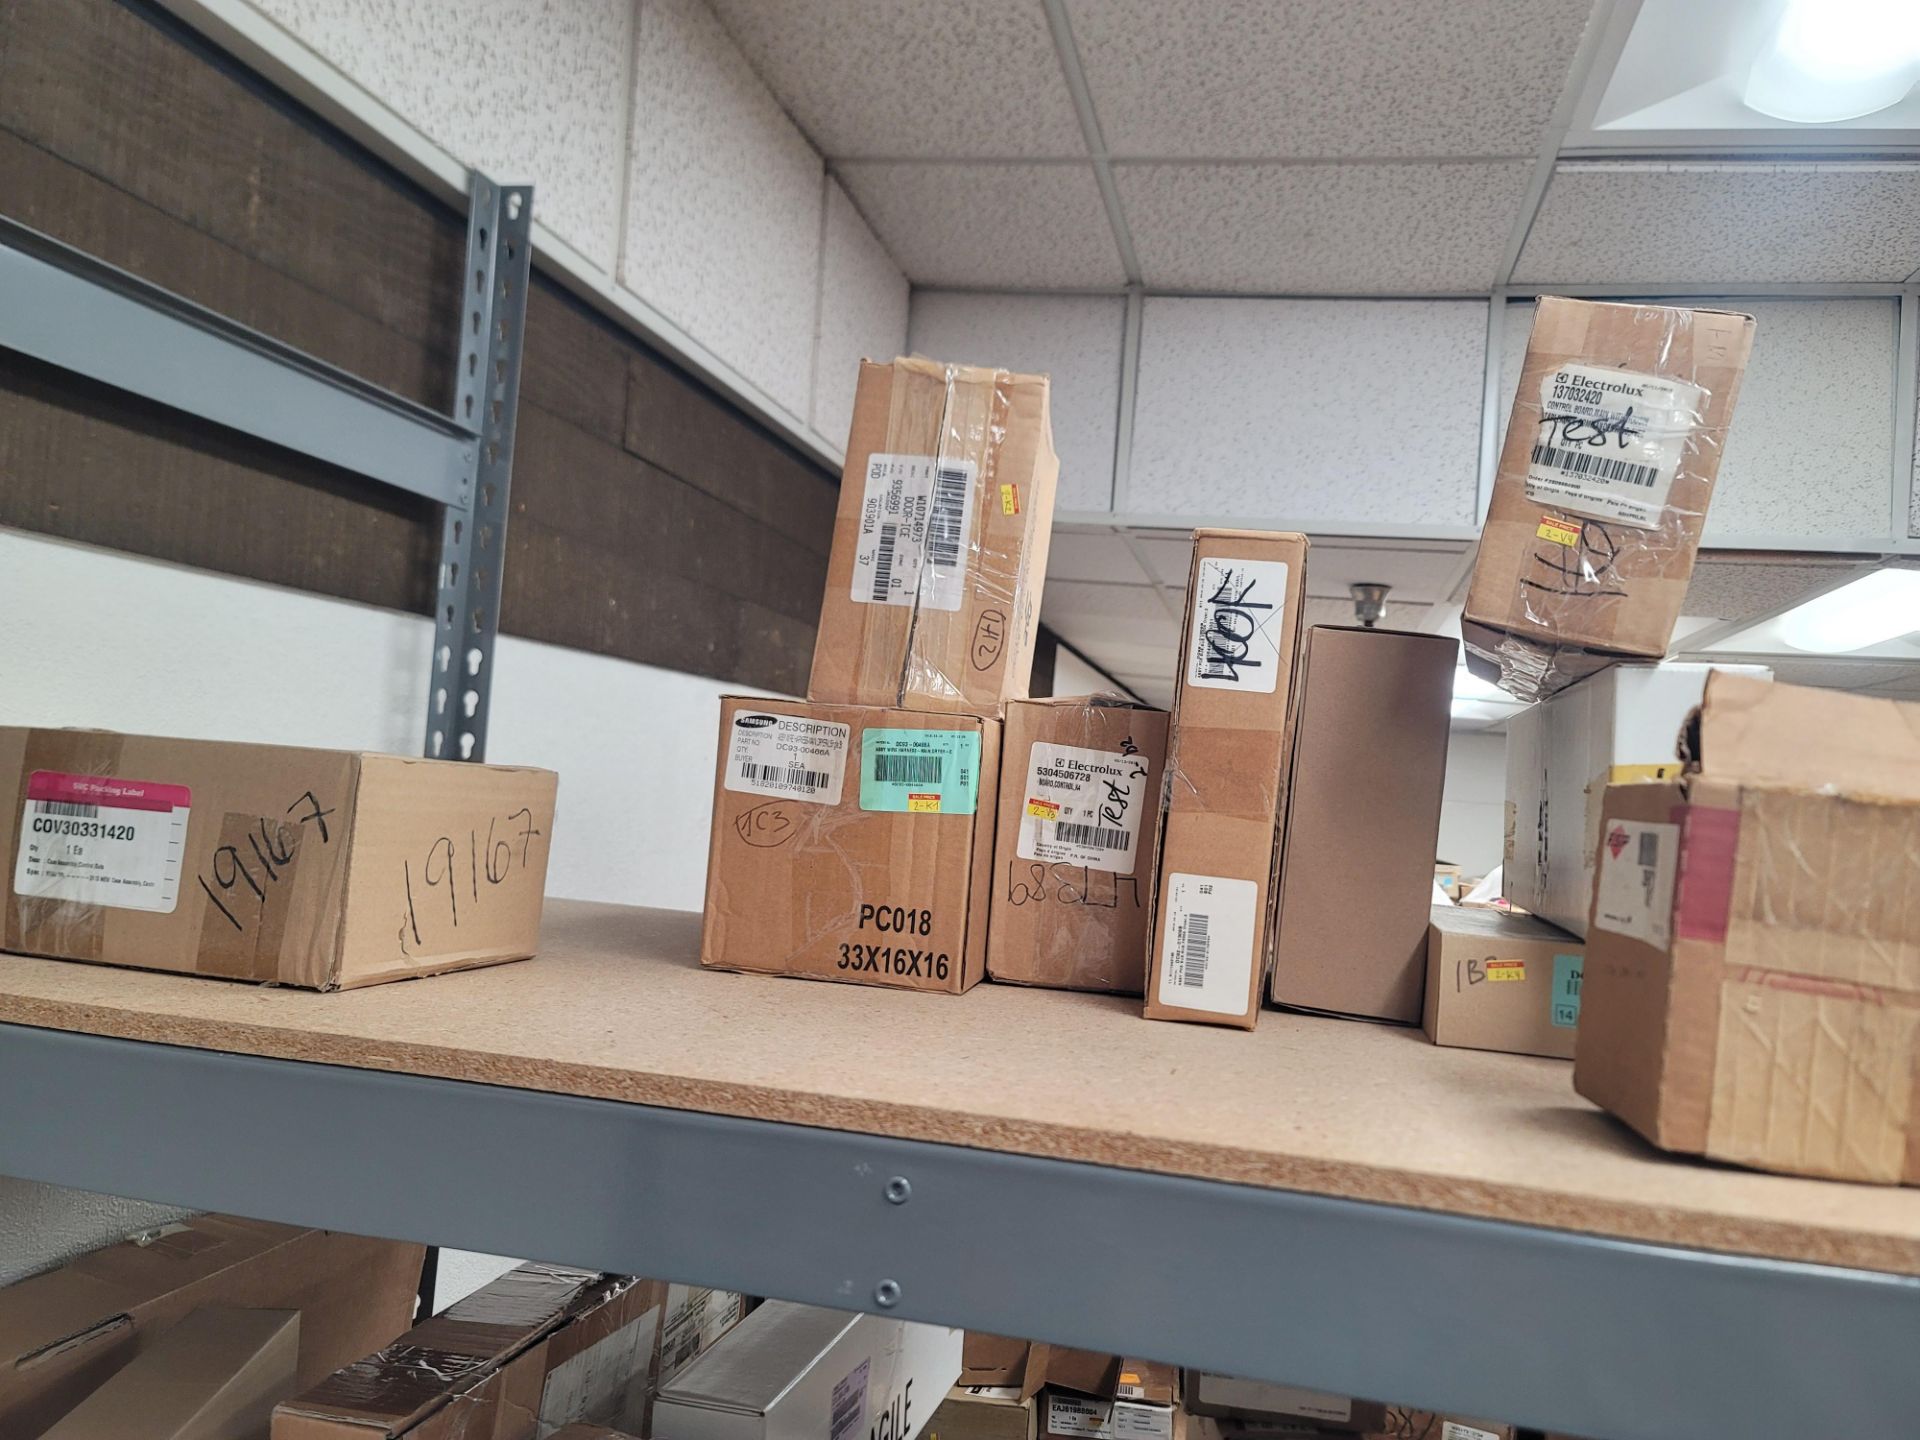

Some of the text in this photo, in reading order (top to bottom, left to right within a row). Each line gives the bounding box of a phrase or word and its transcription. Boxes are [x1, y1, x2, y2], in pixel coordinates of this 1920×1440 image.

[1553, 385, 1603, 406] 137032420
[1572, 375, 1644, 397] Electrolux
[888, 479, 903, 515] 9356991
[900, 496, 914, 539] DOOR-ICE
[912, 495, 927, 543] W10714973
[740, 717, 773, 727] SAMSUNG
[778, 720, 847, 738] DESCRIPTION
[788, 761, 805, 769] SEA
[1037, 767, 1091, 782] 5304506728
[1068, 760, 1123, 776] Electrolux
[33, 818, 135, 841] COV30331420
[199, 791, 336, 932] 19167
[405, 808, 541, 945] 19167
[858, 904, 932, 936] PC018
[837, 943, 949, 980] 33X16X16
[1456, 955, 1497, 993] 1B
[1559, 1009, 1573, 1020] 14
